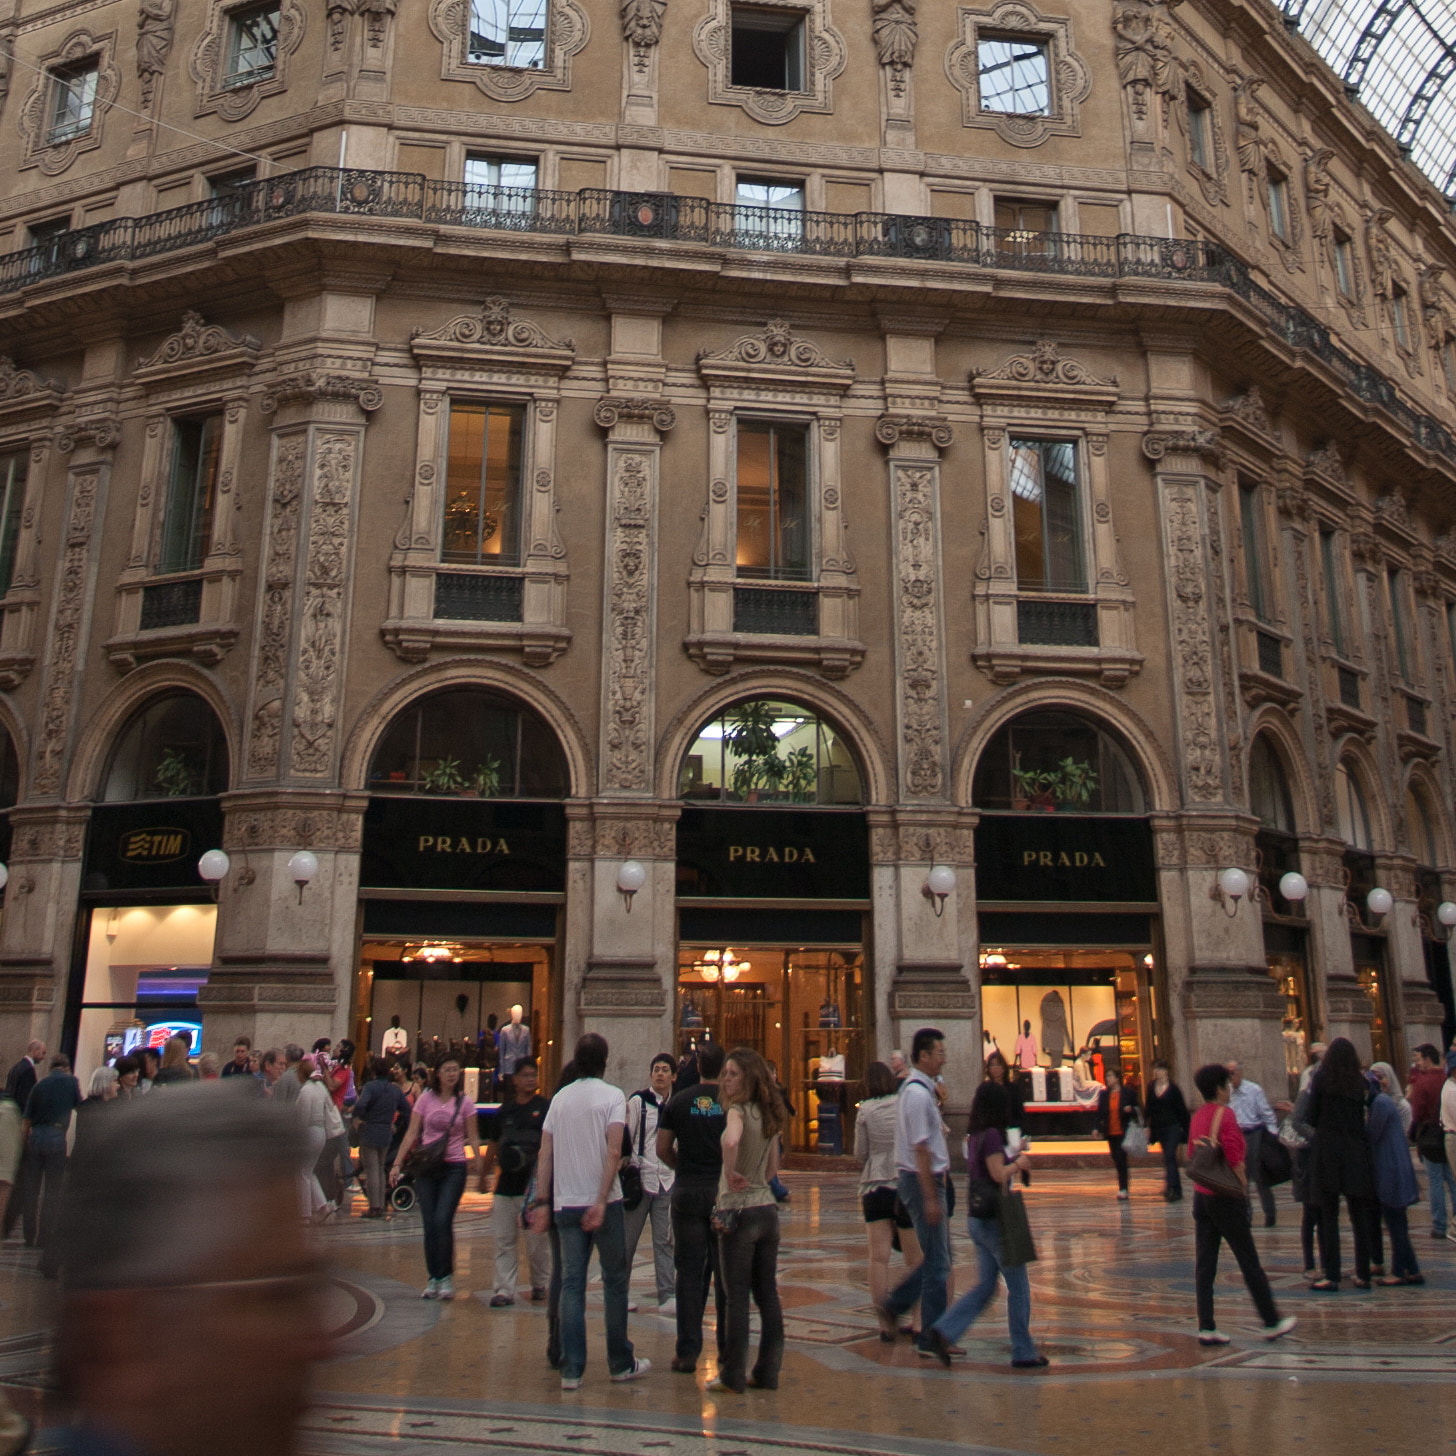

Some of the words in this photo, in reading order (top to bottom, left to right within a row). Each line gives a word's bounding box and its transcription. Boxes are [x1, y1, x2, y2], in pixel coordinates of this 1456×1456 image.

[151, 834, 184, 856] TIM
[418, 835, 511, 855] PRADA
[728, 846, 817, 863] PRADA
[1022, 850, 1106, 868] PRADA
